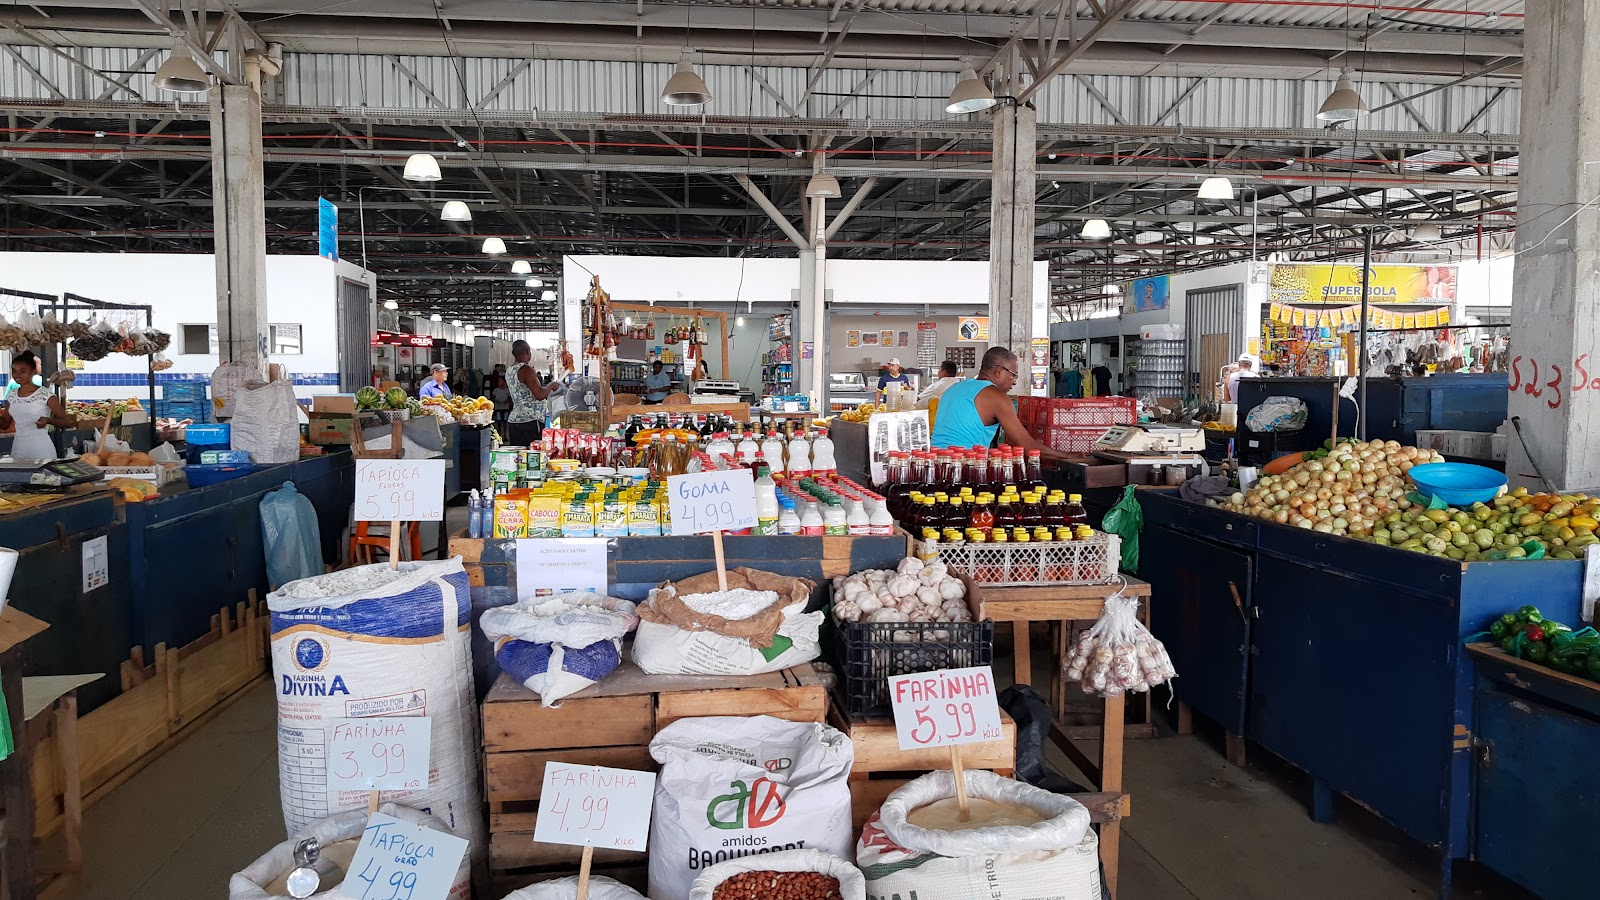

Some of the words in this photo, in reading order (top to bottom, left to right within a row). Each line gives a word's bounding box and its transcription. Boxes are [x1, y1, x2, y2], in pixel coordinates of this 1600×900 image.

[1322, 286, 1361, 295] SUPER
[1367, 286, 1396, 296] BOLA
[357, 462, 420, 483] TAPIOCA
[679, 480, 731, 500] GOMA
[530, 509, 558, 518] CABOCLO
[282, 674, 350, 696] DIVINA
[896, 671, 990, 703] FARINHA
[350, 701, 388, 711] PRODUZIDO
[390, 697, 404, 706] POR
[333, 722, 406, 741] FARINHA
[911, 702, 977, 744] 5,99
[334, 742, 406, 779] 3,99
[551, 768, 637, 788] FARINHA
[550, 792, 609, 832] 4,99
[366, 822, 434, 858] TAPIOCA
[722, 834, 767, 847] amidos
